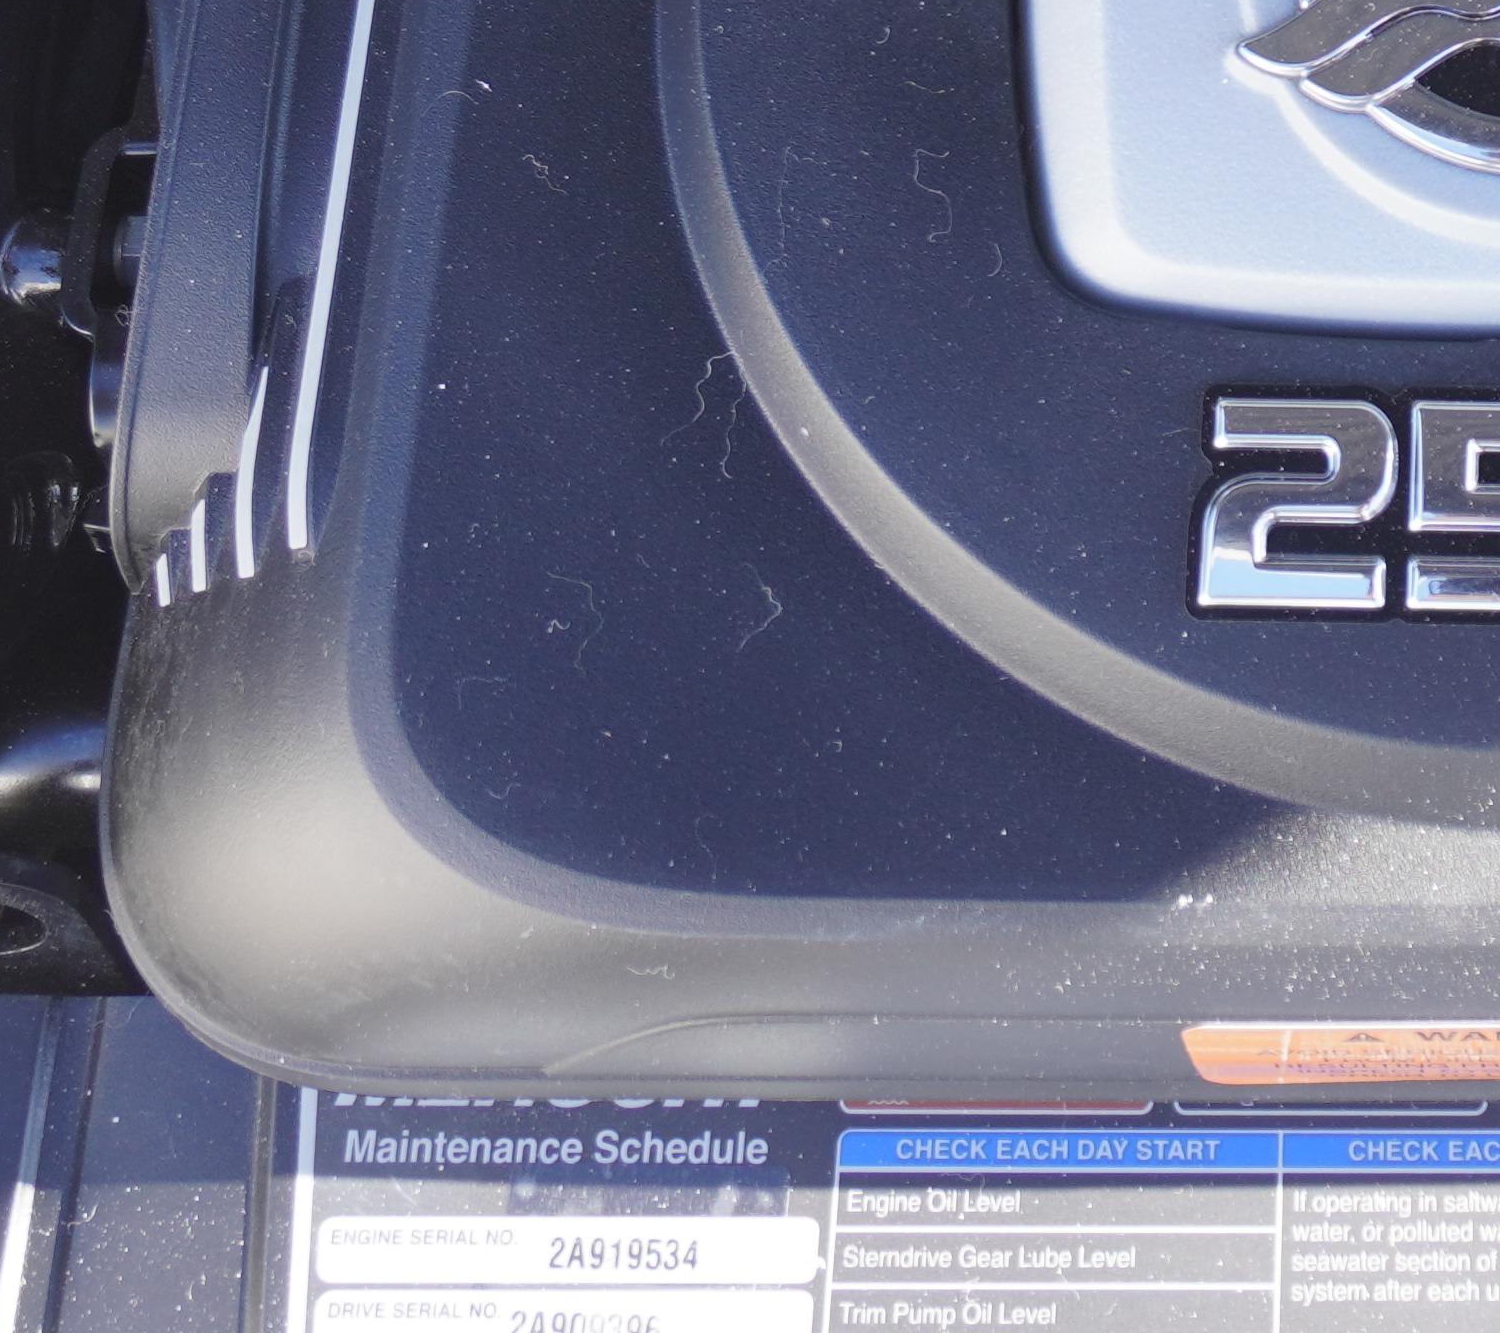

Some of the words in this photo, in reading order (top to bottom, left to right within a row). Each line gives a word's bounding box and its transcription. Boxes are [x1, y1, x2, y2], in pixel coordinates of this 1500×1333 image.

[344, 1129, 583, 1165] Maintenance
[594, 1129, 769, 1165] Schedule
[896, 1139, 987, 1162] CHECK
[996, 1139, 1069, 1162] EACH
[1076, 1139, 1129, 1162] DAY
[1136, 1139, 1220, 1162] START
[1348, 1140, 1439, 1163] CHECK
[846, 1189, 921, 1218] Engine
[927, 1188, 956, 1212] Oil
[964, 1189, 1021, 1213] Level
[1293, 1191, 1308, 1212] If
[1314, 1191, 1412, 1218] operating
[1418, 1191, 1437, 1213] in
[330, 1228, 402, 1246] ENGINE
[410, 1229, 482, 1246] SERIAL
[484, 1229, 518, 1246] NO.
[1291, 1221, 1354, 1244] water,
[1363, 1223, 1383, 1242] or
[1388, 1221, 1473, 1246] polluted
[548, 1236, 698, 1271] 2A919534
[843, 1244, 952, 1268] Sterndrive
[958, 1245, 1012, 1268] Gear
[1018, 1245, 1072, 1268] Lube
[1079, 1245, 1136, 1268] Level
[1291, 1251, 1389, 1272] seawater
[1395, 1250, 1471, 1272] section
[1477, 1249, 1498, 1272] of
[1290, 1281, 1367, 1303] system
[1373, 1280, 1421, 1301] after
[1427, 1280, 1481, 1301] each
[327, 1301, 388, 1319] DRIVE
[392, 1301, 462, 1319] SERIAL
[839, 1302, 886, 1325] Trim
[892, 1302, 956, 1330] Pump
[962, 1301, 993, 1325] Oil
[999, 1302, 1057, 1325] Level
